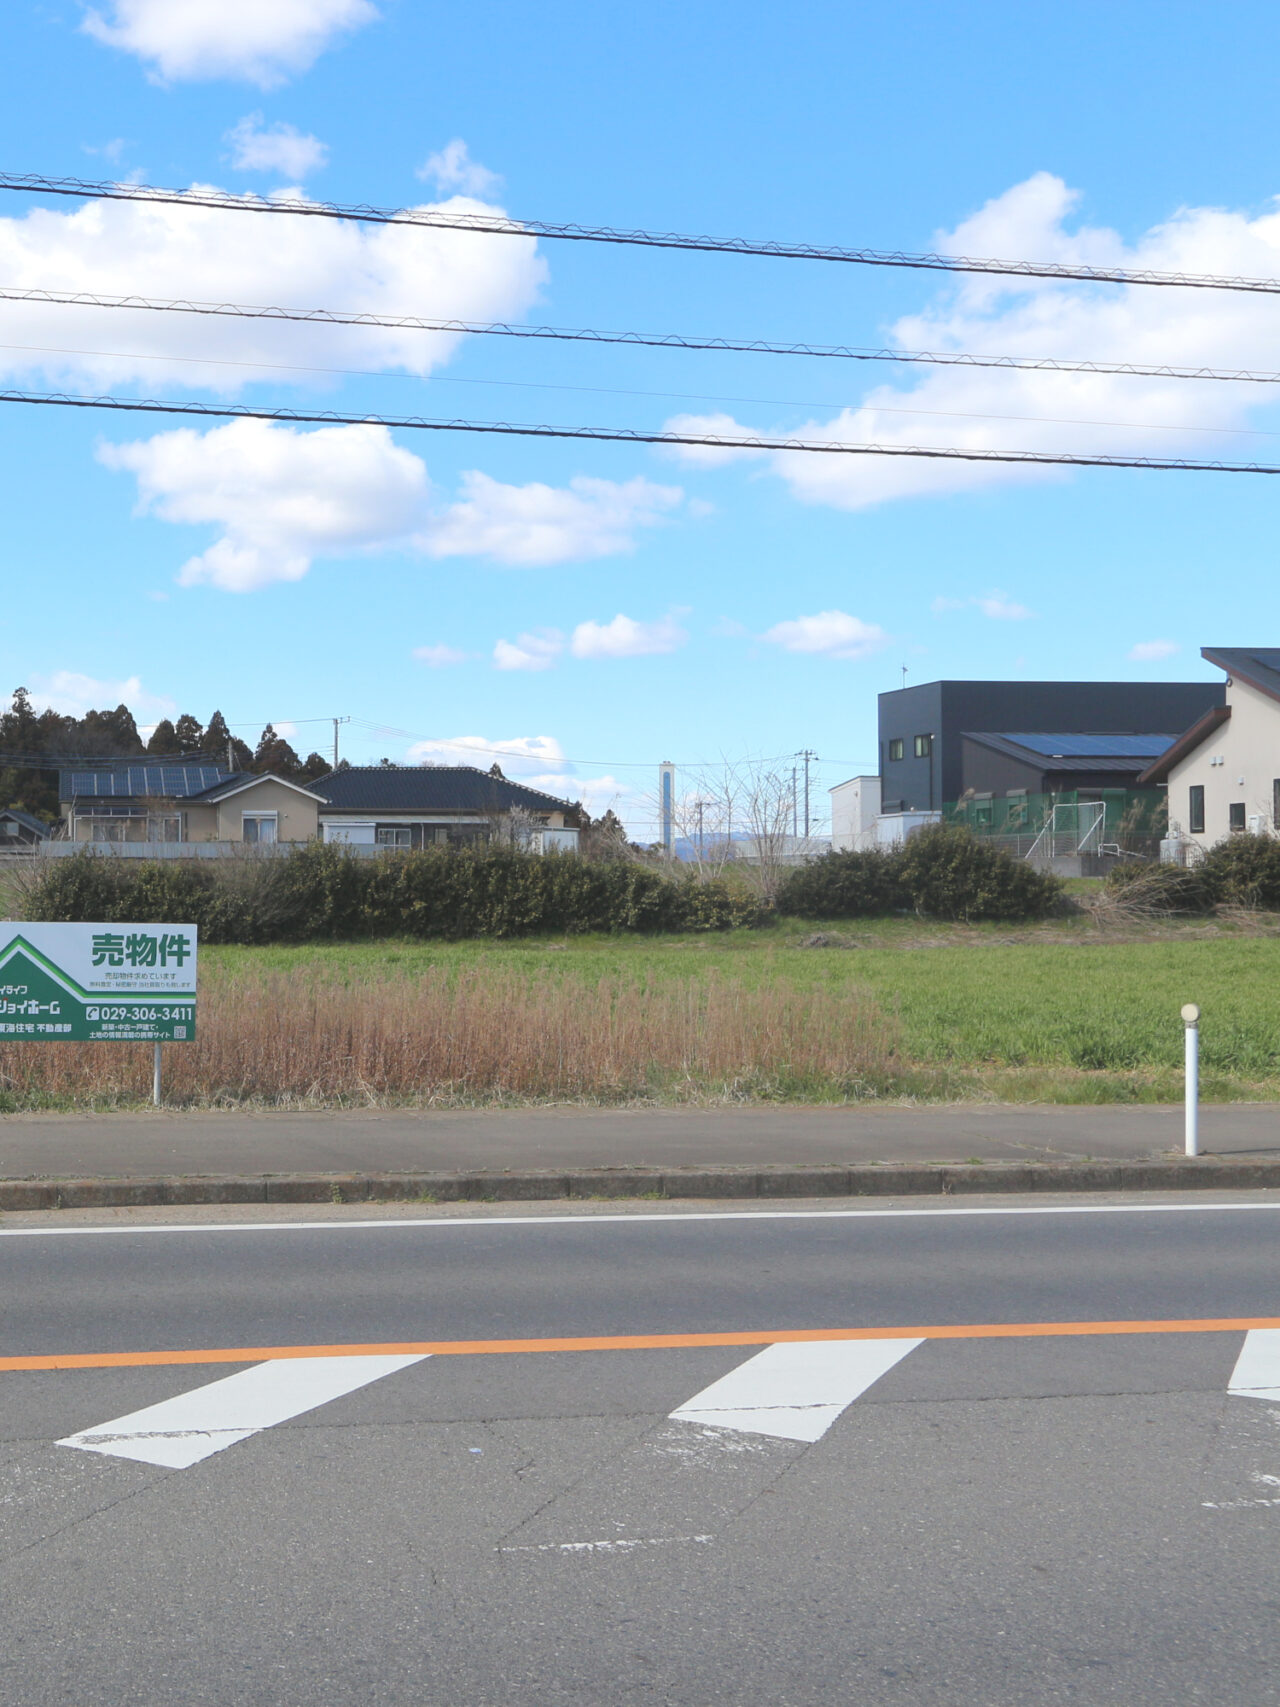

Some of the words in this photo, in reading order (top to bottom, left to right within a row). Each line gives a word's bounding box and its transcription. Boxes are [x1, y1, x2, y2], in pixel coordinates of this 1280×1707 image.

[91, 933, 191, 967] 売物件
[104, 972, 177, 980] 売却物件求めています
[101, 1007, 192, 1020] 029-306-3411
[36, 1023, 72, 1033] 不動産部
